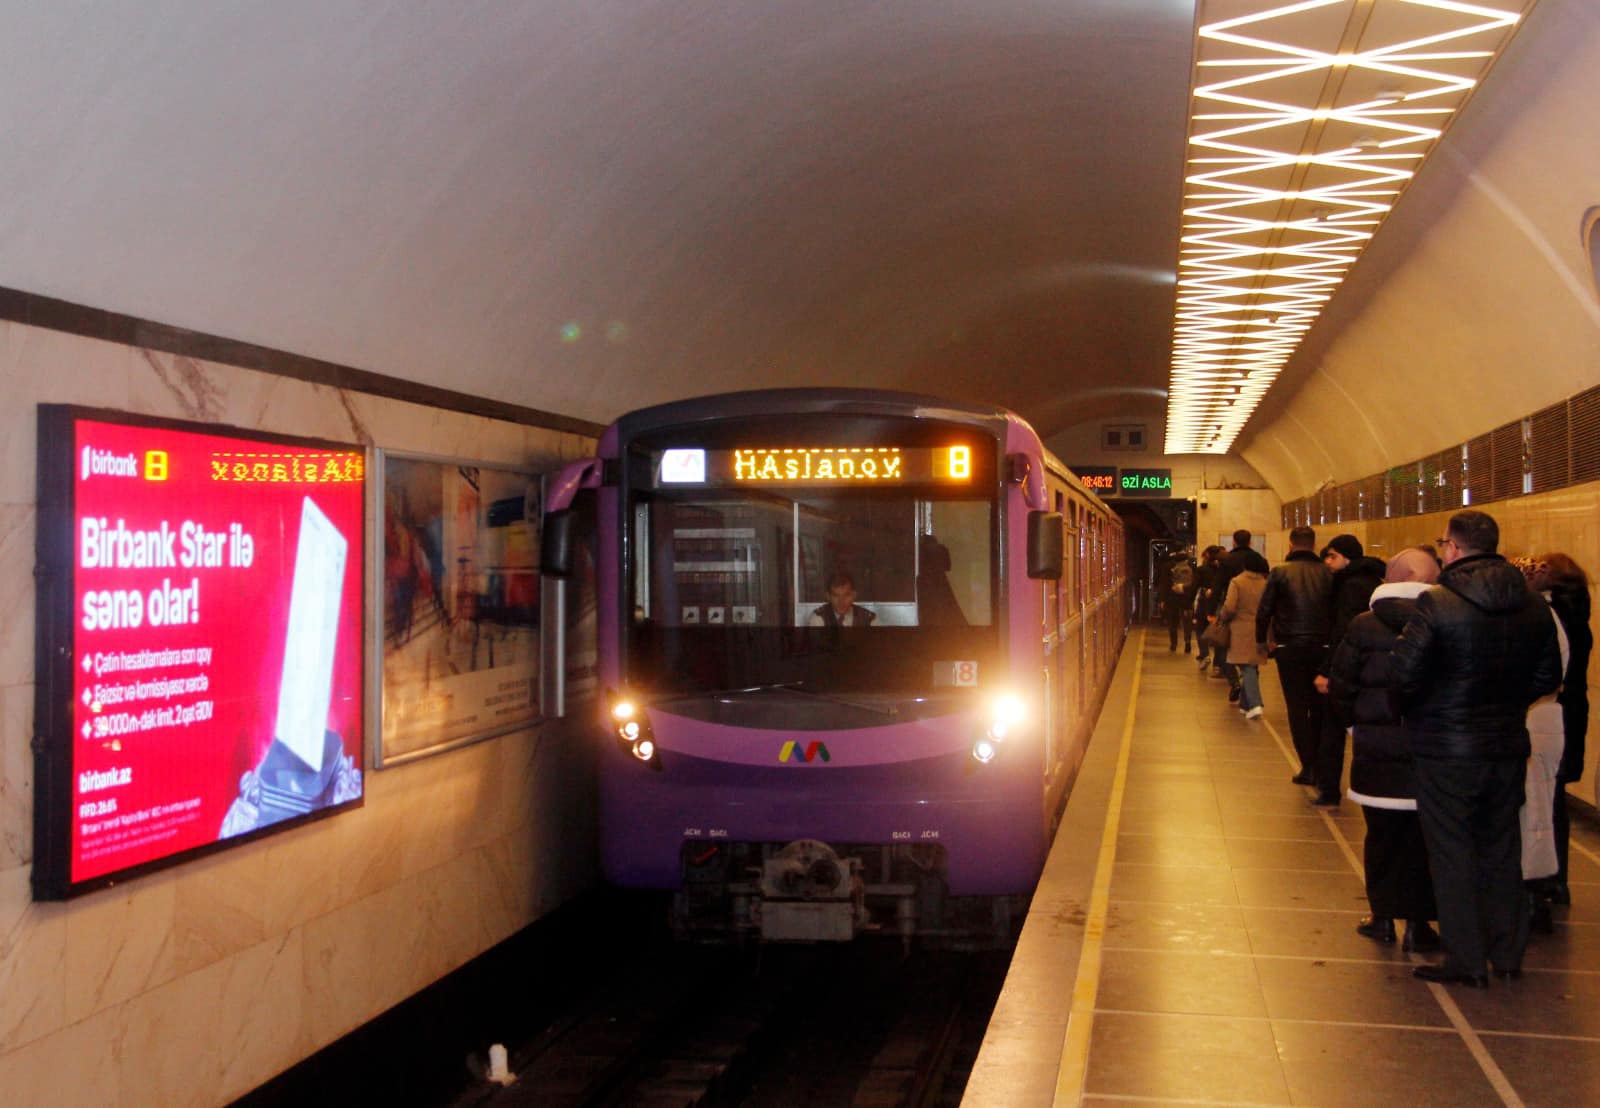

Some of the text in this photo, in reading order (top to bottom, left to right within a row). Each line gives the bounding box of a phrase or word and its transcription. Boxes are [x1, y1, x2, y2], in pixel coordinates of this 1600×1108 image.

[92, 449, 137, 477] birbank
[950, 446, 969, 479] 8
[1142, 477, 1171, 489] ASLA
[81, 517, 254, 568] Birbank Star ilə
[82, 577, 199, 631] sənə olar!
[959, 662, 975, 683] 8
[80, 766, 132, 794] birbank.az
